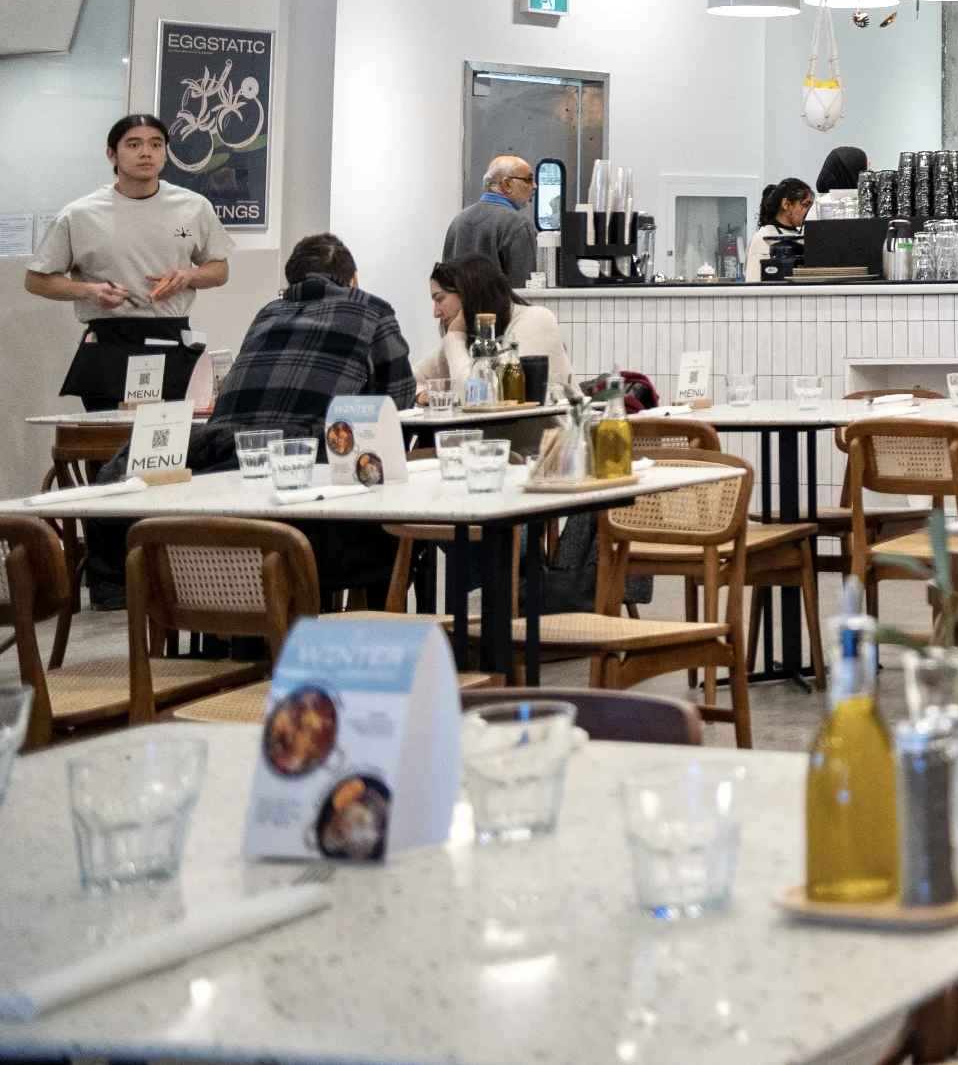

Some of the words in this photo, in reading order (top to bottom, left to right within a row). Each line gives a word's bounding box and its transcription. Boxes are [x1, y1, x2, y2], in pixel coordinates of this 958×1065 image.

[168, 33, 265, 54] EGGSTATIC
[127, 389, 160, 399] MENU
[679, 388, 706, 398] MENU
[334, 404, 376, 414] WINTER
[131, 453, 183, 471] MENU
